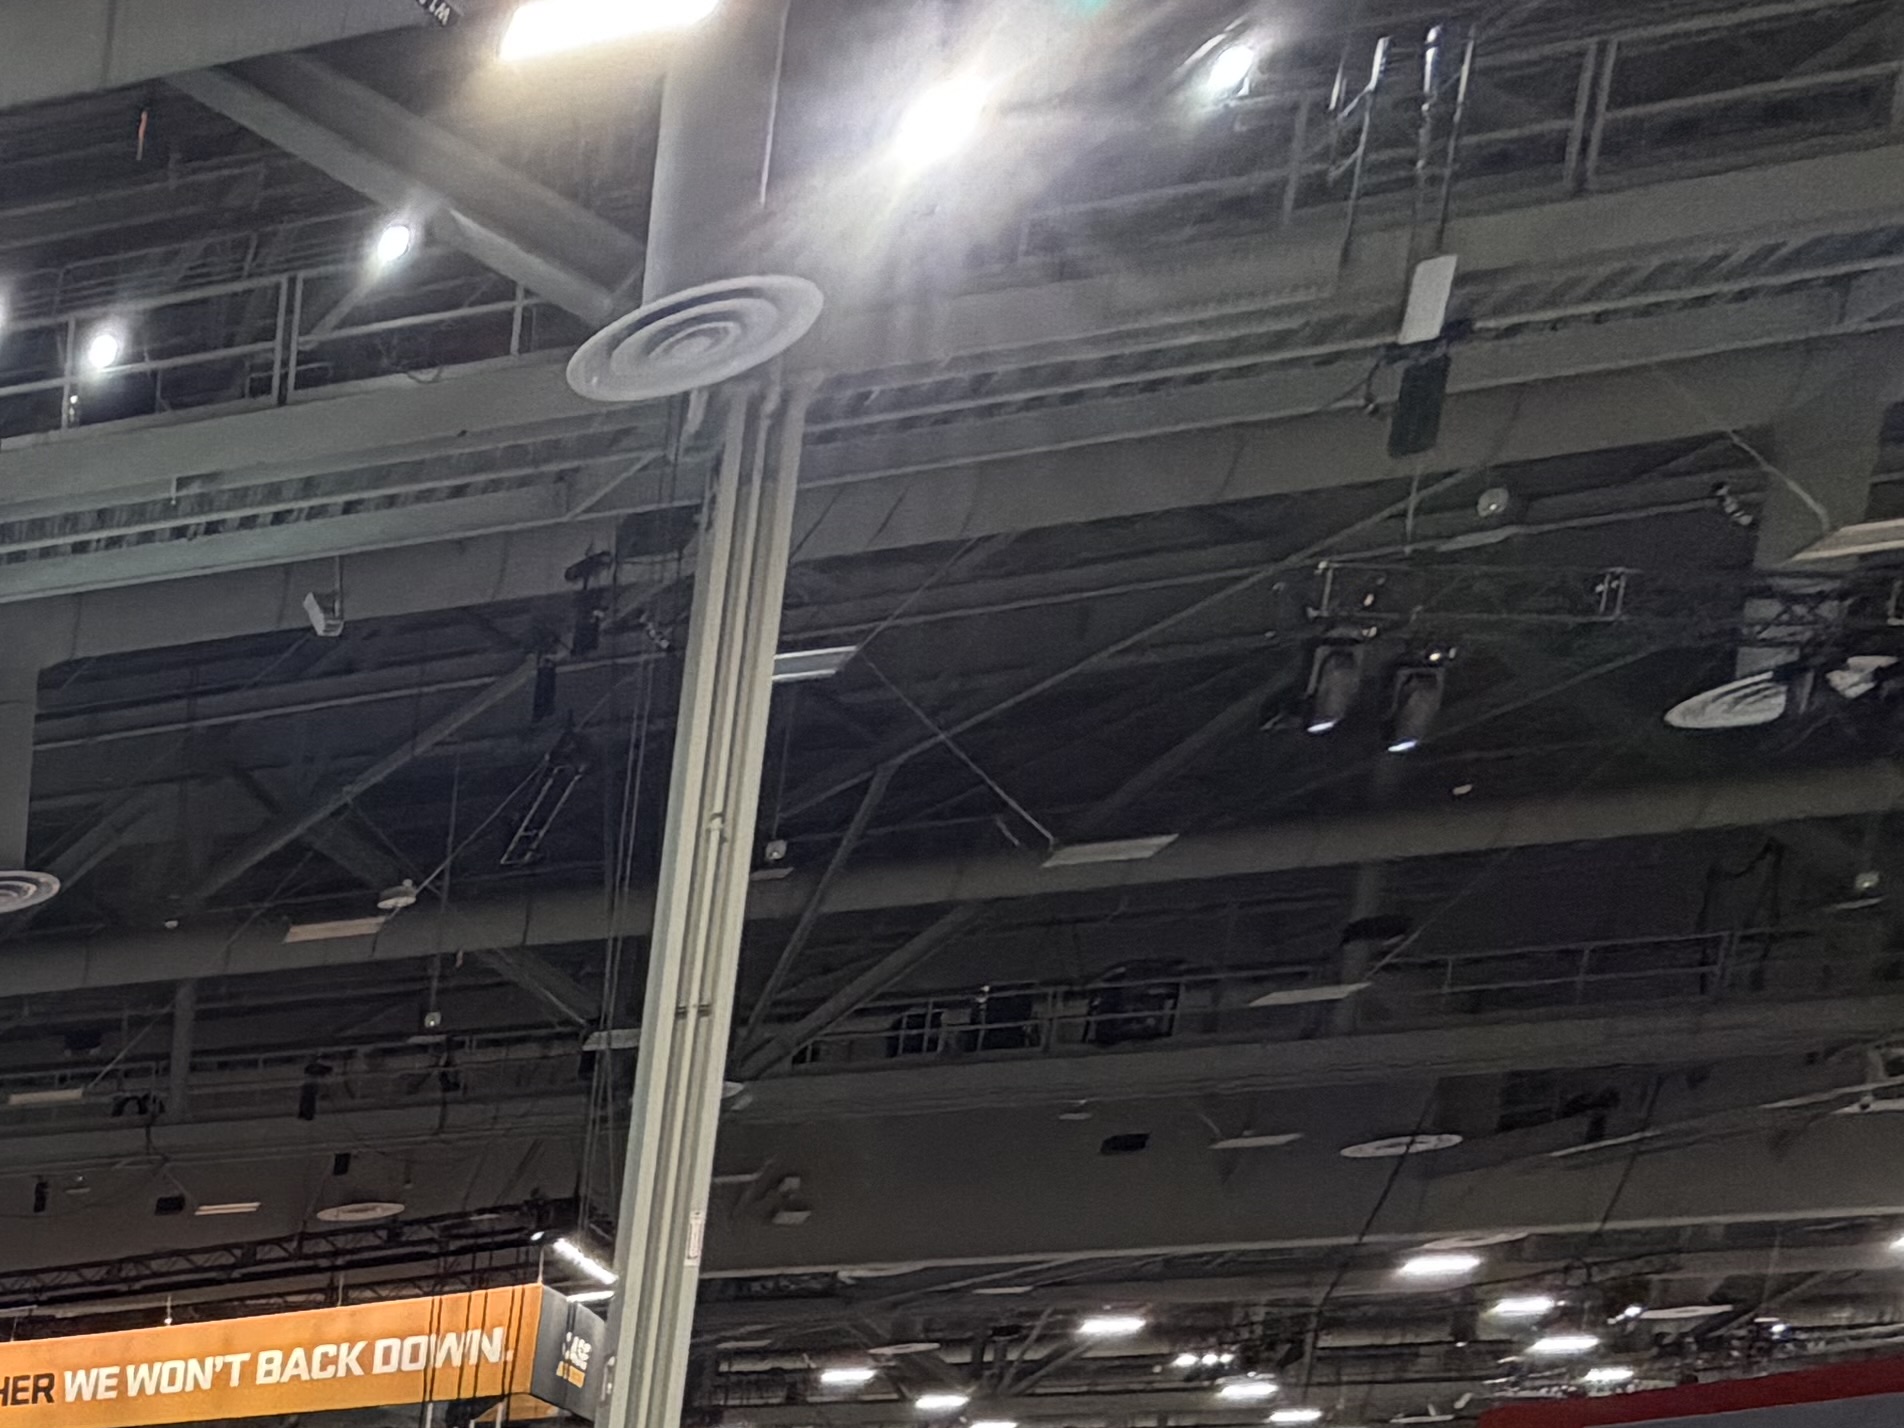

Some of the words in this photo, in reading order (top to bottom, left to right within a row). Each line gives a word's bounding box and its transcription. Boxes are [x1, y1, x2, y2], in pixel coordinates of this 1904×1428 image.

[62, 1364, 120, 1403] WE
[125, 1351, 251, 1397] WON'T
[255, 1340, 364, 1386] BACK
[370, 1326, 514, 1375] DOWN.
